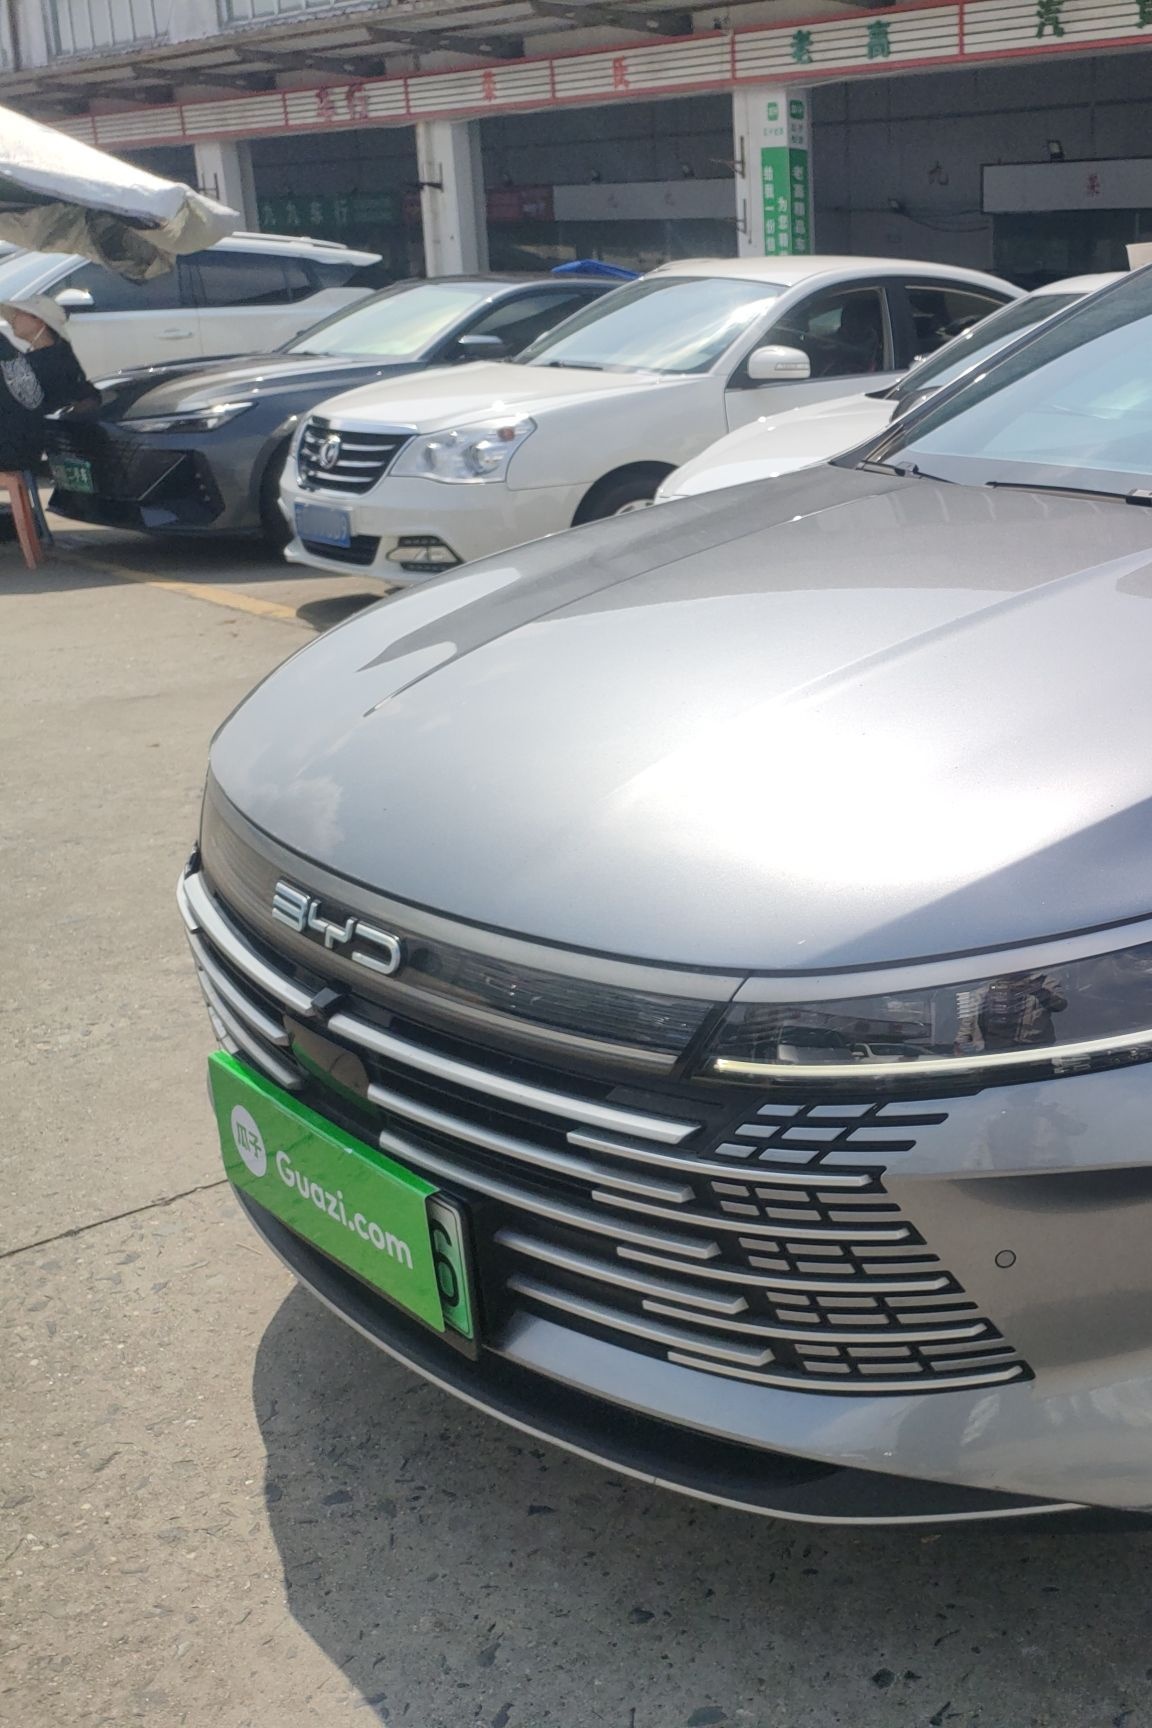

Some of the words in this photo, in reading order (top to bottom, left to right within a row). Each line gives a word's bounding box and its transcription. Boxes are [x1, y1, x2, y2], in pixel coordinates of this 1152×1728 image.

[272, 879, 401, 975] BYD
[236, 1123, 263, 1159] 瓜子
[276, 1150, 414, 1270] Guazi.com
